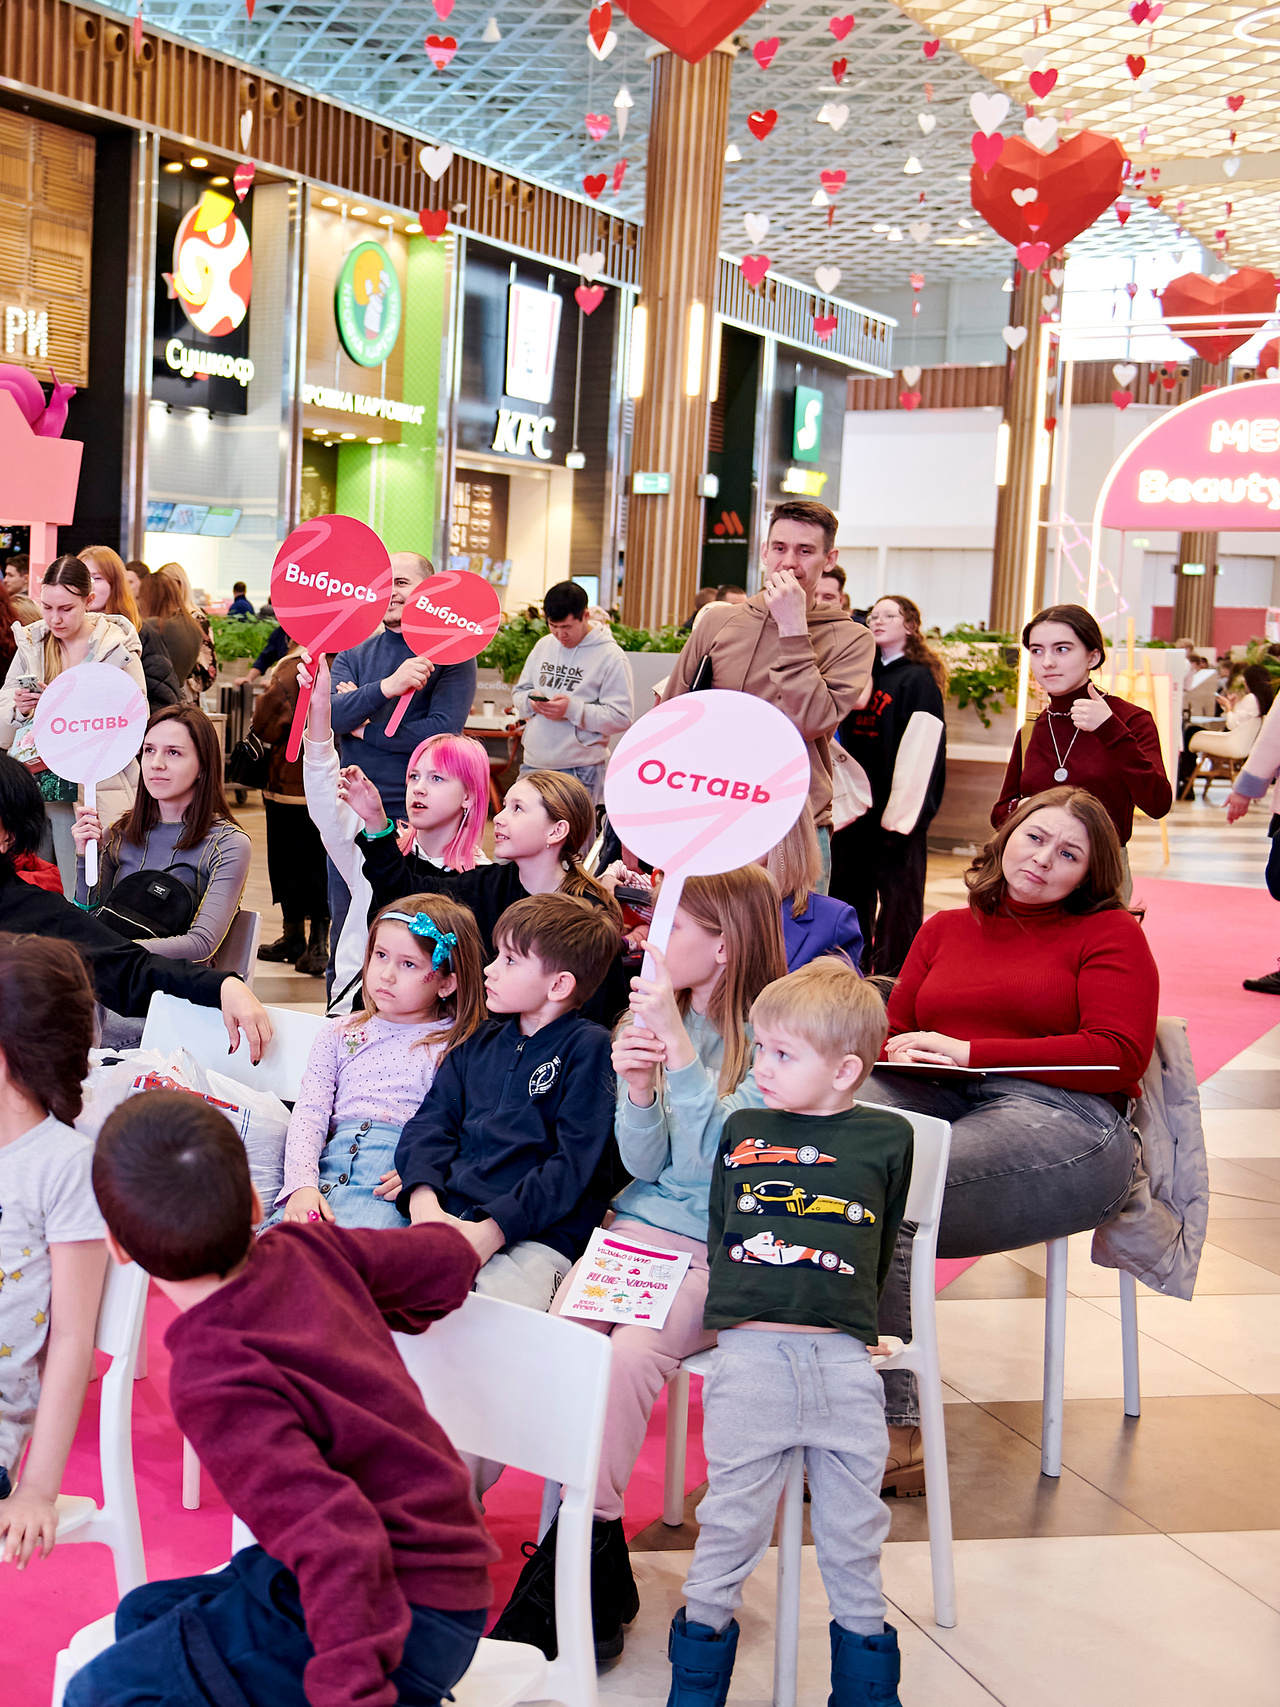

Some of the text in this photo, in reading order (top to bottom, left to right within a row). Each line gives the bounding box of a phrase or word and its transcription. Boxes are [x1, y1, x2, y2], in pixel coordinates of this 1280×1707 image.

[165, 338, 255, 388] Сушкоф
[491, 408, 557, 460] KFC
[1209, 418, 1280, 453] ME
[284, 562, 378, 604] Выбрось
[415, 595, 485, 637] Выбрось
[50, 715, 129, 735] Оставь
[637, 759, 771, 804] Оставь
